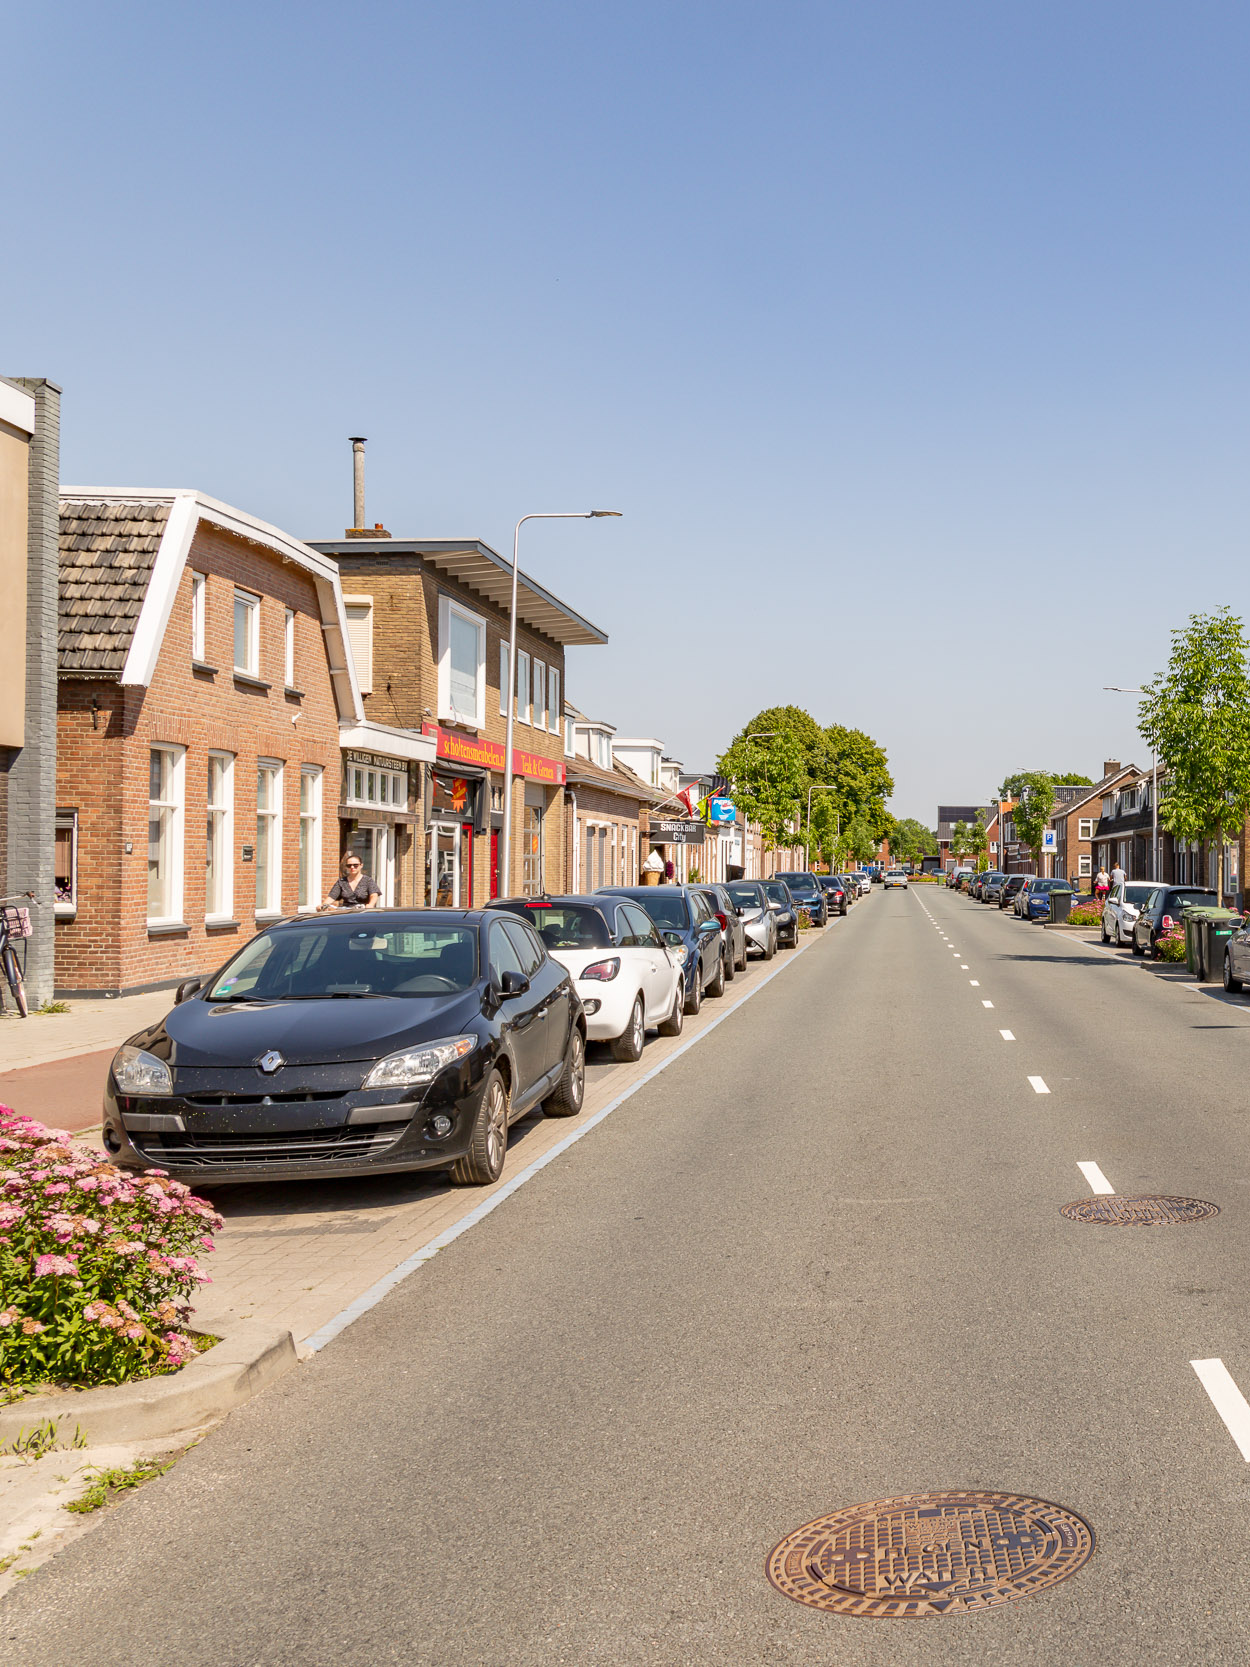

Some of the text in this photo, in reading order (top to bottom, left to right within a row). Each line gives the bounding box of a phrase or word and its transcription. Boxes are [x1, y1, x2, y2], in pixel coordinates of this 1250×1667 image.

[444, 735, 506, 768] scholtensmeubelen.nl
[521, 755, 532, 775] Teak
[532, 759, 538, 775] &
[660, 824, 697, 832] SNACKBAR
[673, 832, 687, 842] City
[884, 1539, 984, 1559] REGEN
[883, 1566, 989, 1587] WATER
